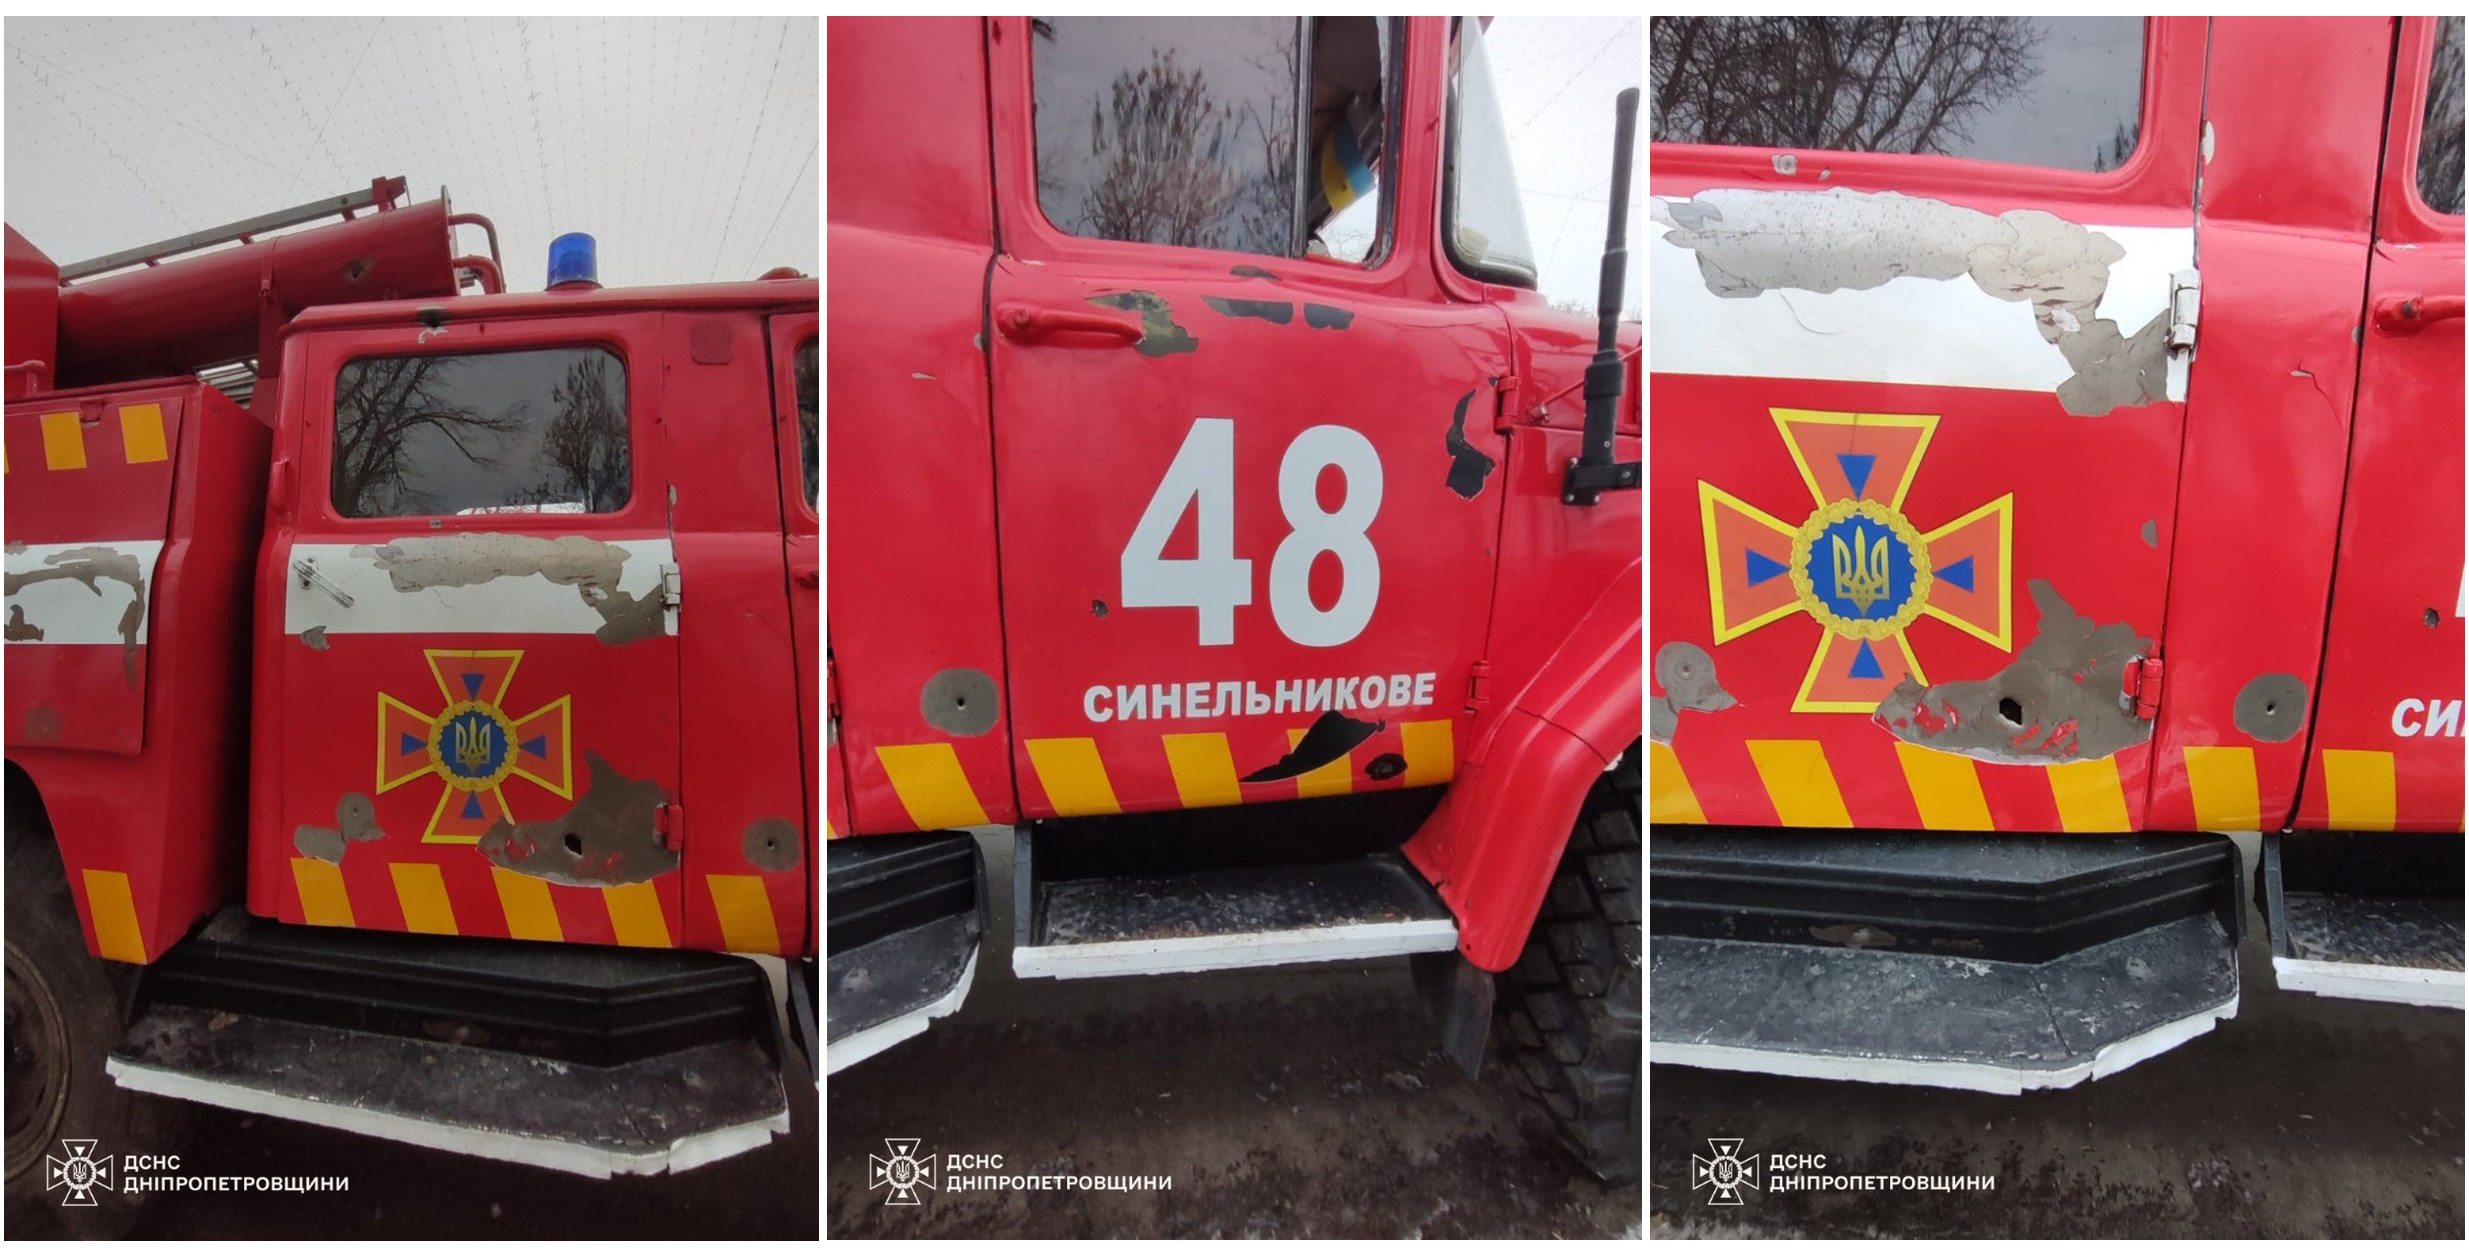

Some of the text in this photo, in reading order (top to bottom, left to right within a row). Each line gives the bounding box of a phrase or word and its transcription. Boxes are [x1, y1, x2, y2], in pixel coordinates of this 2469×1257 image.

[1120, 417, 1384, 647] 48
[1083, 672, 1436, 723] СИНЕЛЬНИКОВЕ
[2391, 698, 2465, 738] СИ
